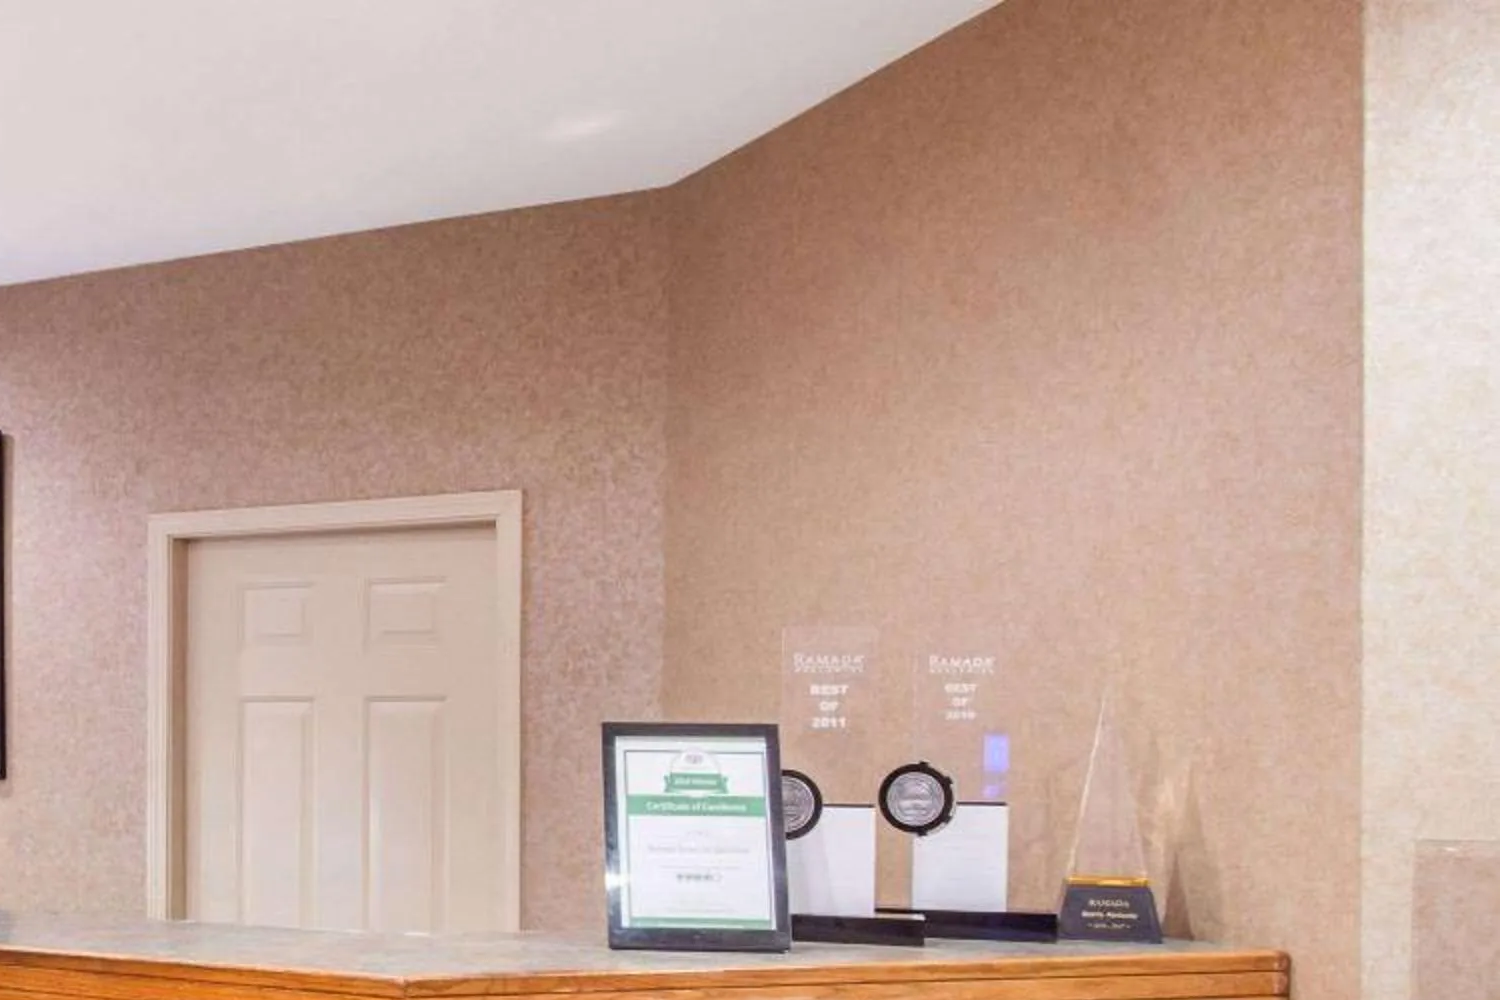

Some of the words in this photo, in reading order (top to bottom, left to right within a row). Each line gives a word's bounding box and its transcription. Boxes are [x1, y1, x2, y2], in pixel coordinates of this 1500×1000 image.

[809, 683, 849, 696] BEST
[943, 682, 977, 694] BEST
[818, 699, 839, 712] OF
[951, 696, 969, 708] OF
[811, 715, 847, 729] 2011
[646, 801, 690, 812] Certificate
